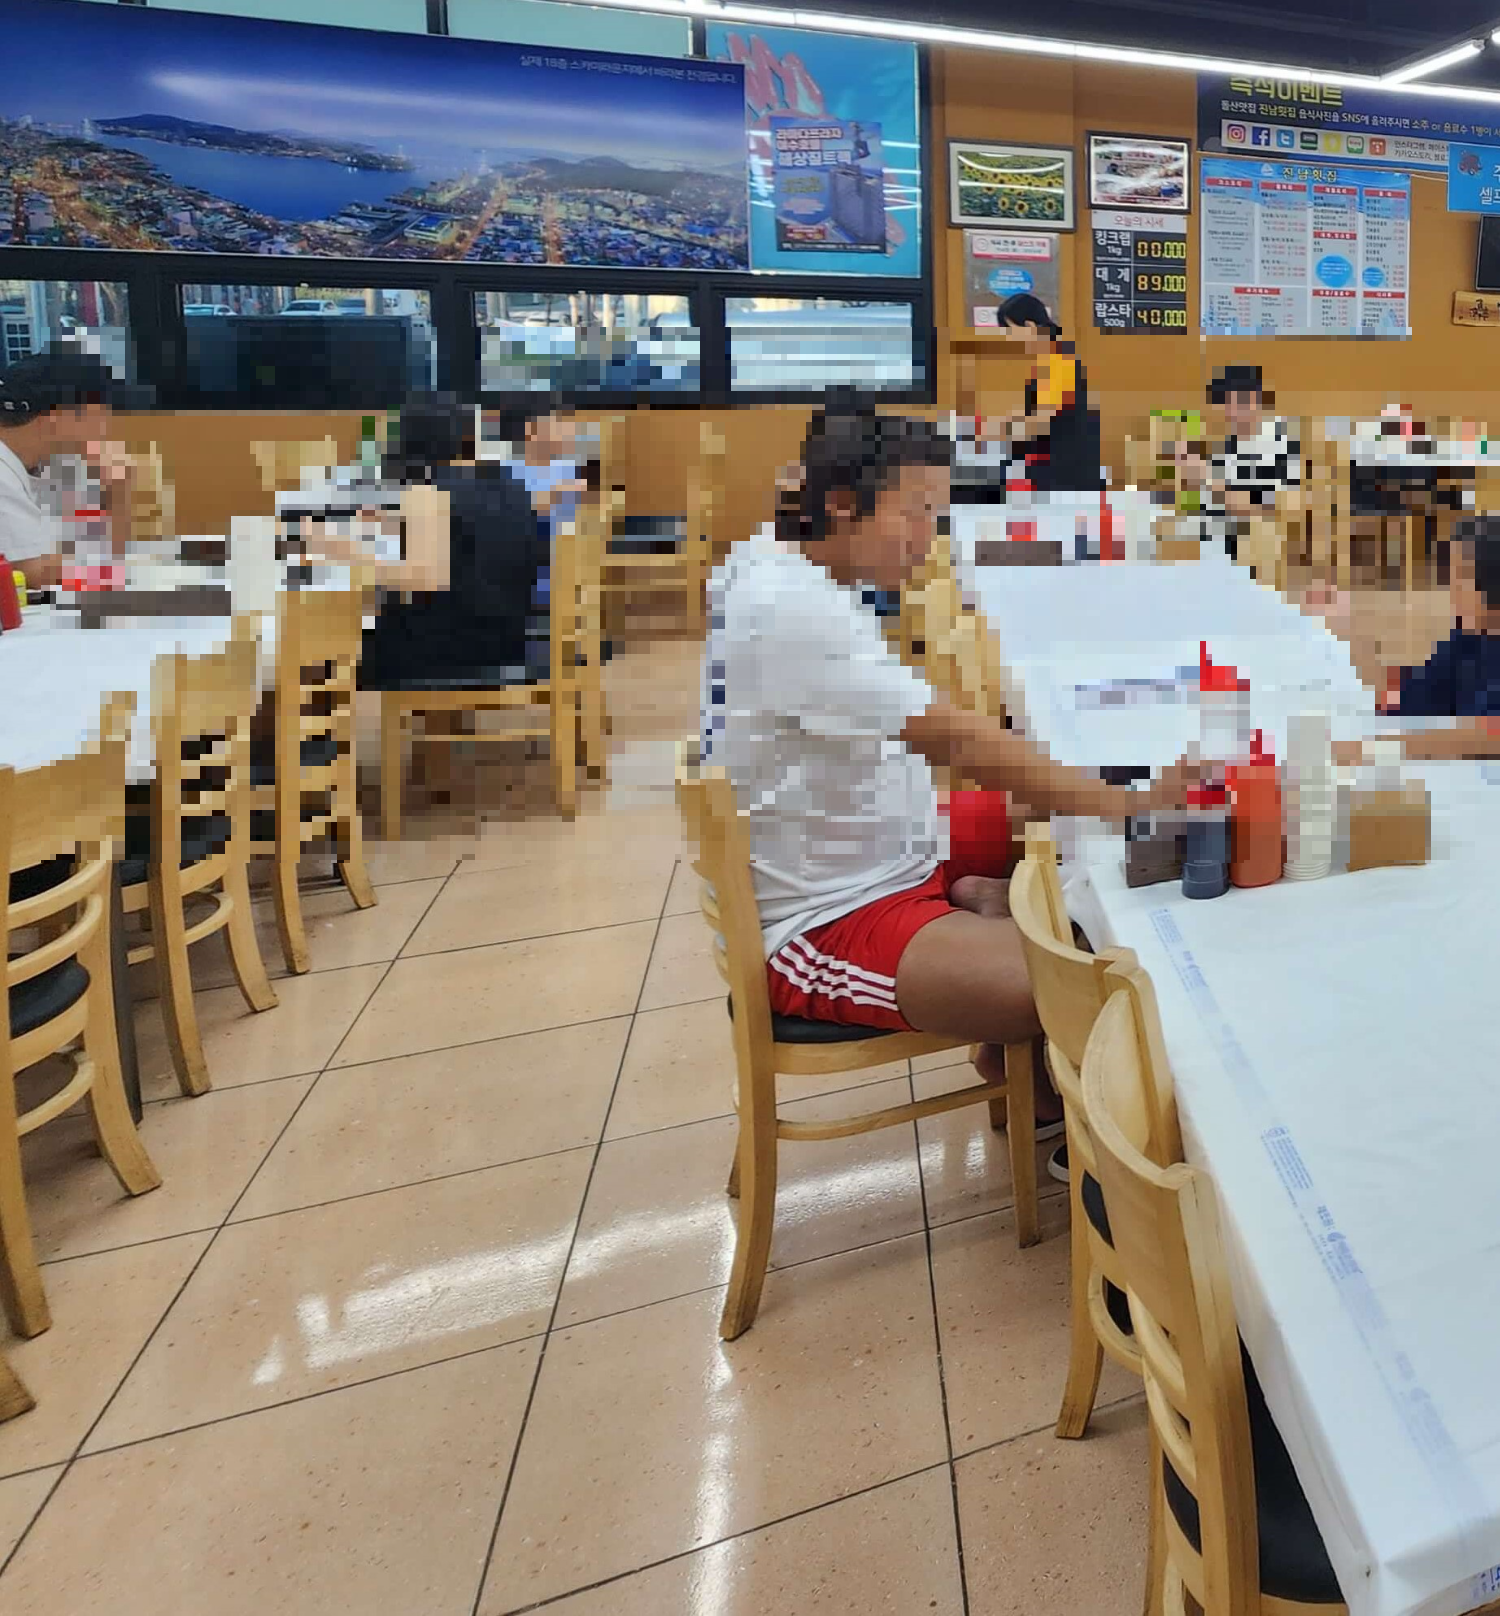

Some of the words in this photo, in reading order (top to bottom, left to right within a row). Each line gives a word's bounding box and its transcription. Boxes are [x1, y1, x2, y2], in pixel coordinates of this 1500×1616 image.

[1258, 103, 1296, 118] 진남횟집
[1341, 112, 1370, 125] SNS에
[1411, 119, 1430, 130] 소주
[1431, 123, 1441, 131] or
[1443, 123, 1469, 134] 음료수
[1114, 214, 1142, 227] 오늘의
[1144, 217, 1164, 228] 시세
[1094, 230, 1131, 247] 킹크랩
[1107, 245, 1122, 256] 1kg
[1105, 282, 1121, 293] 1kg
[1104, 318, 1126, 327] 500g
